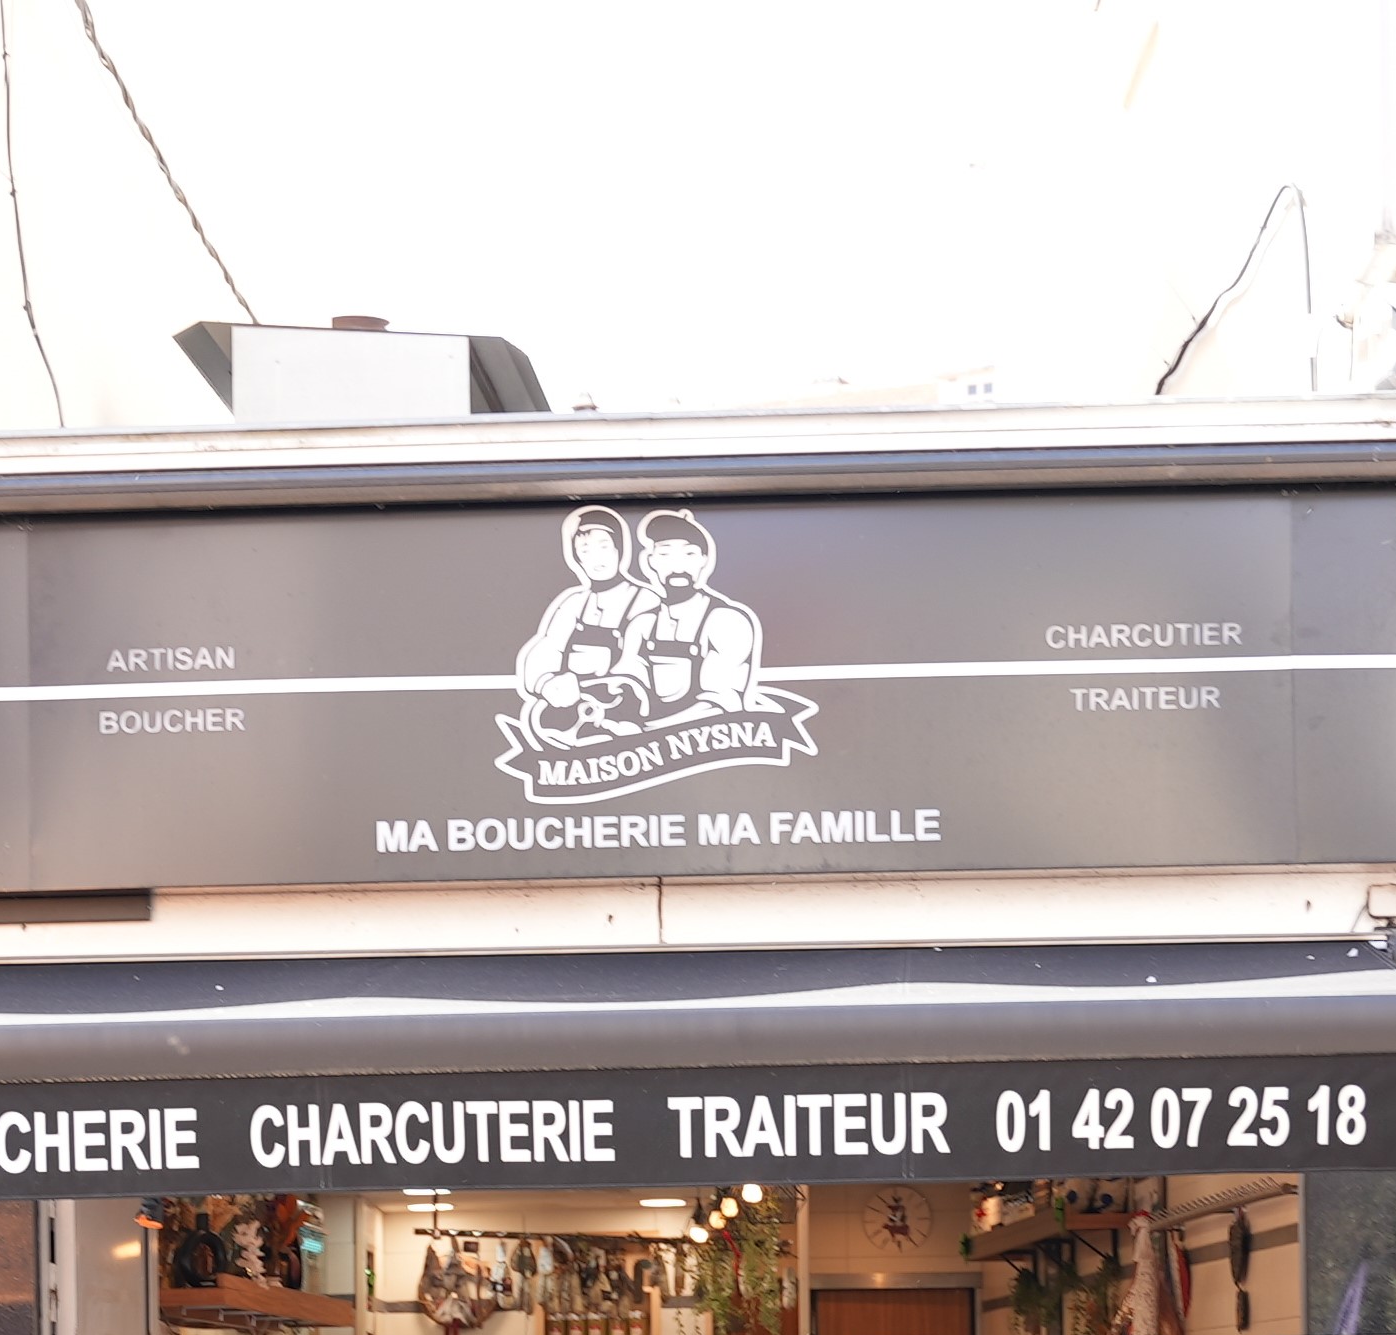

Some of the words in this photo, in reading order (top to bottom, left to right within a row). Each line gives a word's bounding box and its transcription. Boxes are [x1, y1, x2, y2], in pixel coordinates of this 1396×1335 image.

[1045, 622, 1243, 649] CHARCUTIER
[106, 646, 235, 673] ARTISAN
[1069, 686, 1221, 712] TRAITEUR
[98, 707, 246, 734] BOUCHER
[537, 740, 665, 787] MAISON
[668, 721, 777, 759] NYSNA
[375, 819, 439, 853] MA
[447, 814, 686, 852] BOUCHERIE
[697, 812, 761, 847] MA
[770, 808, 941, 845] FAMILLE
[250, 1099, 616, 1168] CHARCUTERIE
[667, 1091, 951, 1159] TRAITEUR
[995, 1088, 1053, 1153] 01
[1070, 1087, 1135, 1151] 42
[1149, 1086, 1213, 1149] 07
[1227, 1085, 1291, 1148] 25
[1306, 1084, 1368, 1146] 18
